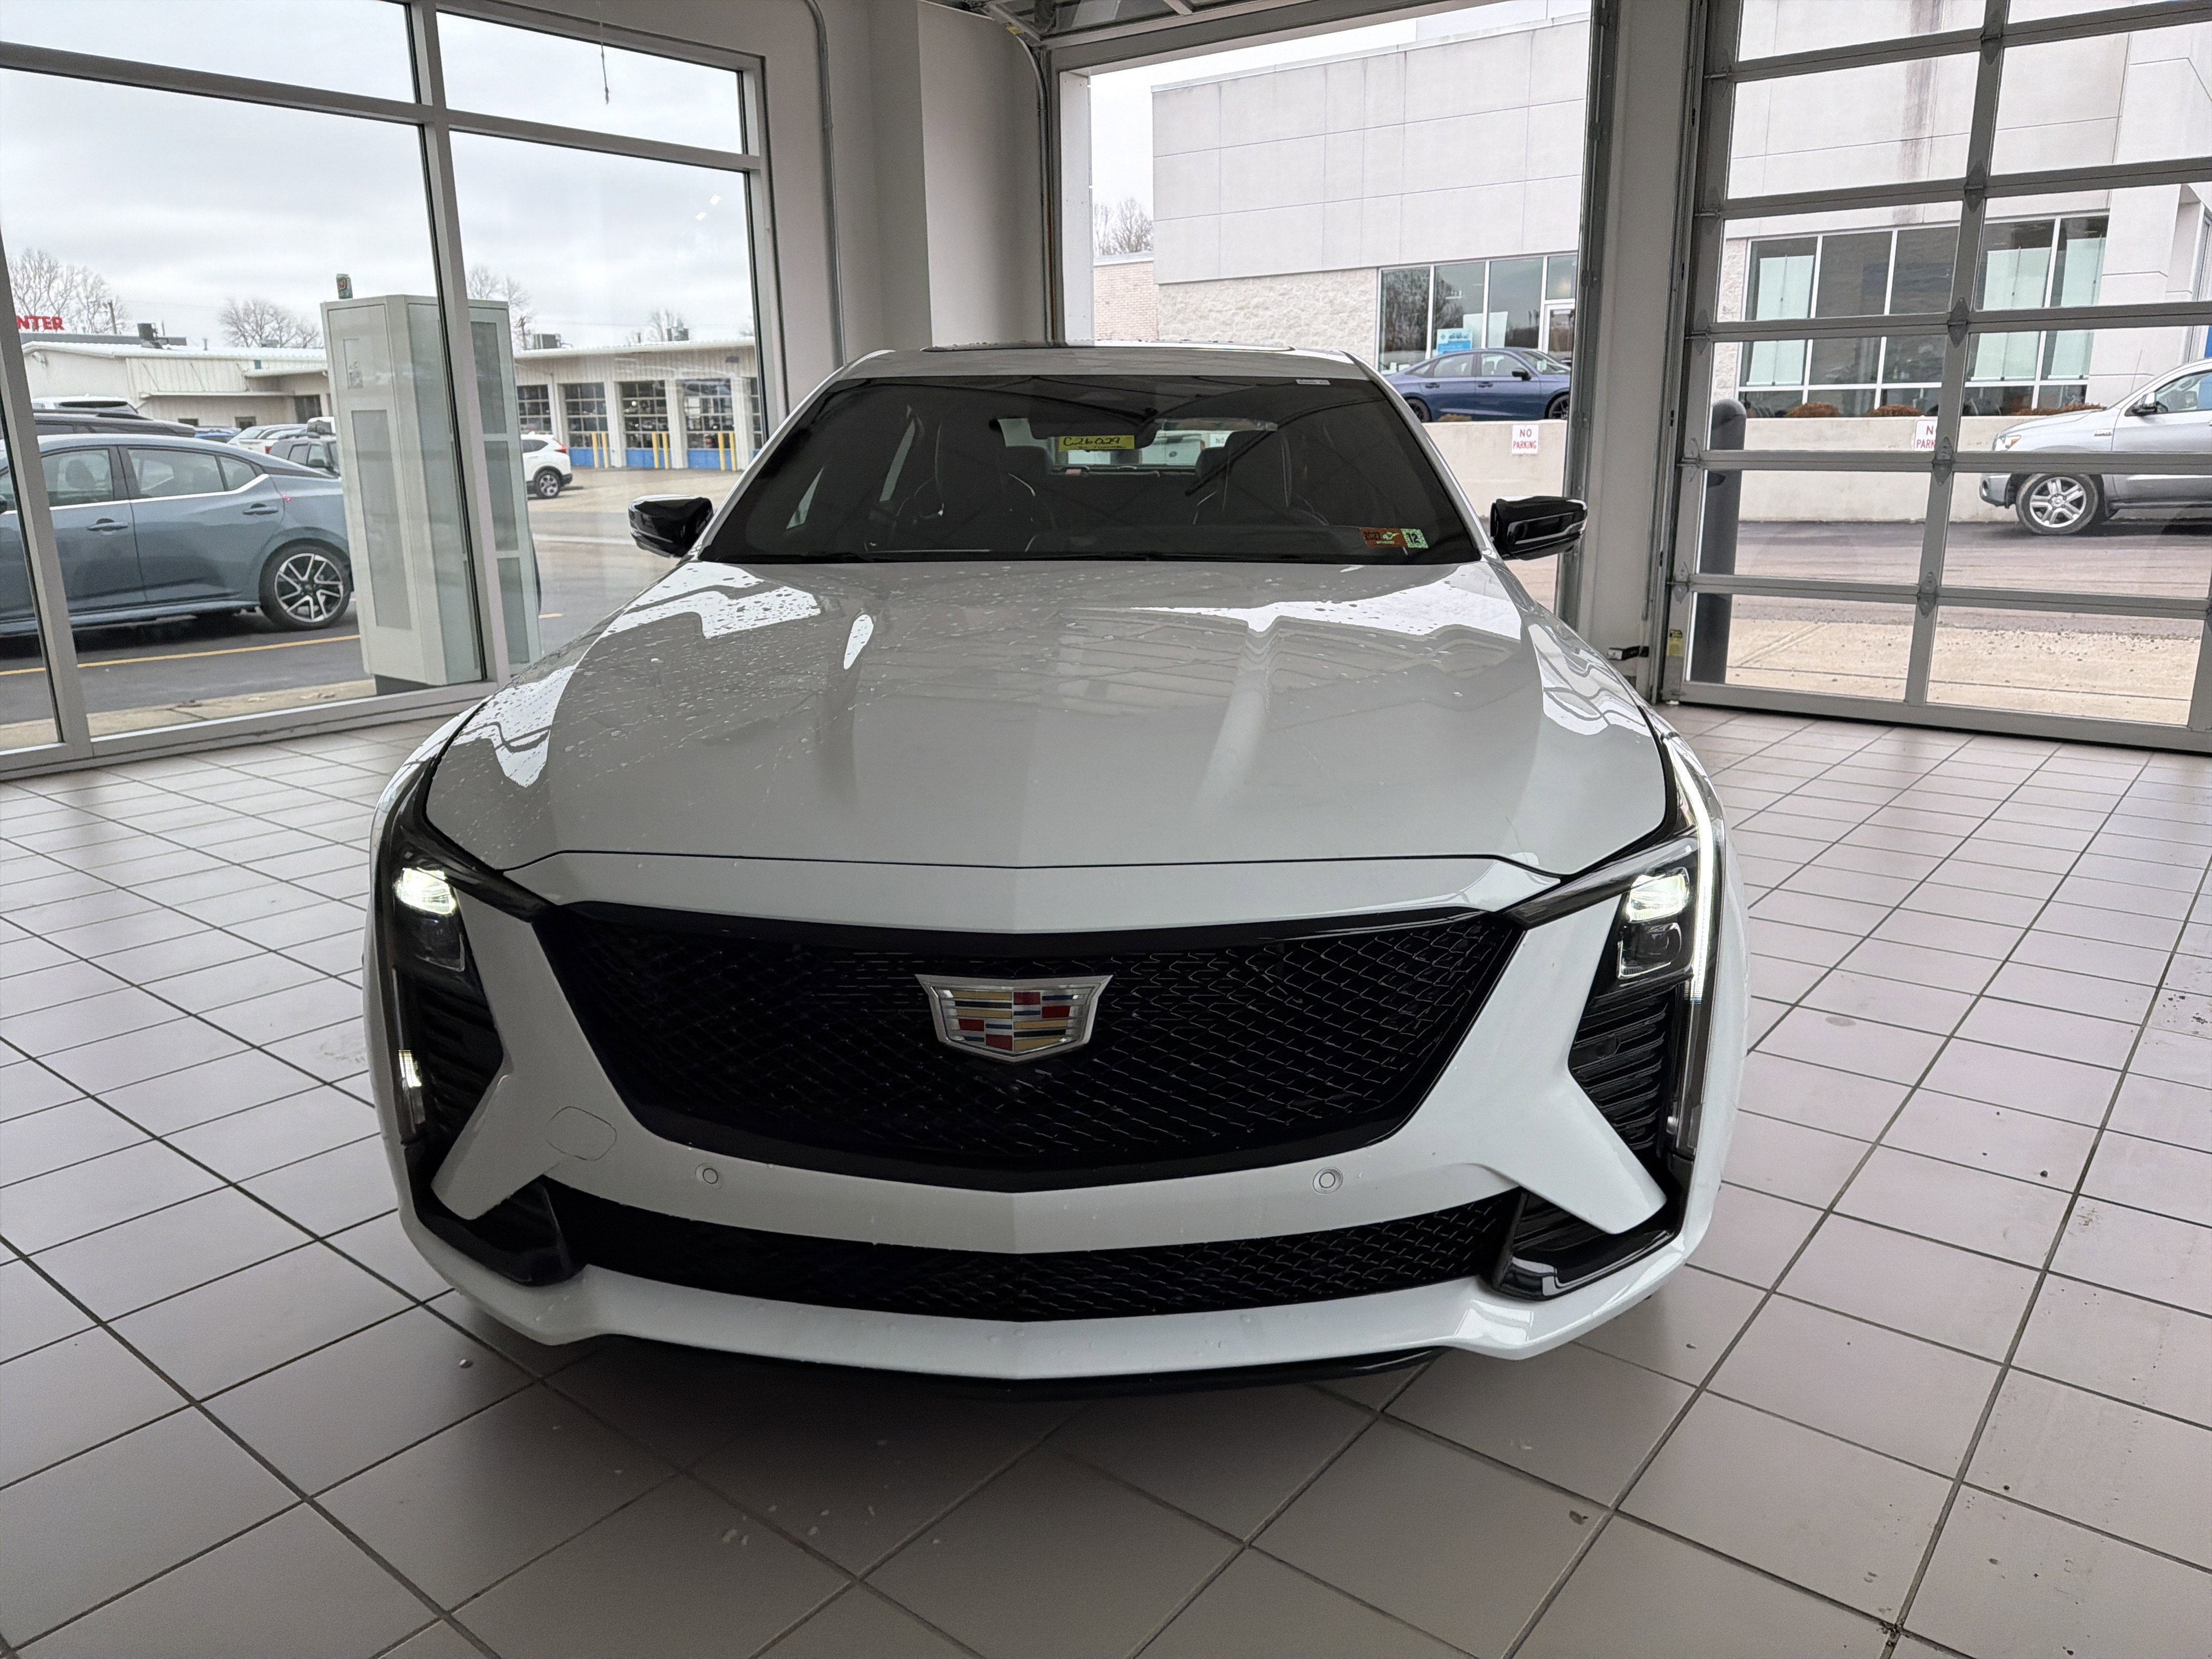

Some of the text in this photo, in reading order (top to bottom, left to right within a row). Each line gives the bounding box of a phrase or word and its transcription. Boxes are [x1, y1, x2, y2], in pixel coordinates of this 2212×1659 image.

[16, 315, 65, 331] NTER
[1520, 428, 1532, 437] NO
[1926, 425, 1934, 435] N
[1513, 441, 1537, 449] PARKING
[1916, 439, 1936, 449] PARK
[1406, 533, 1420, 544] 12
